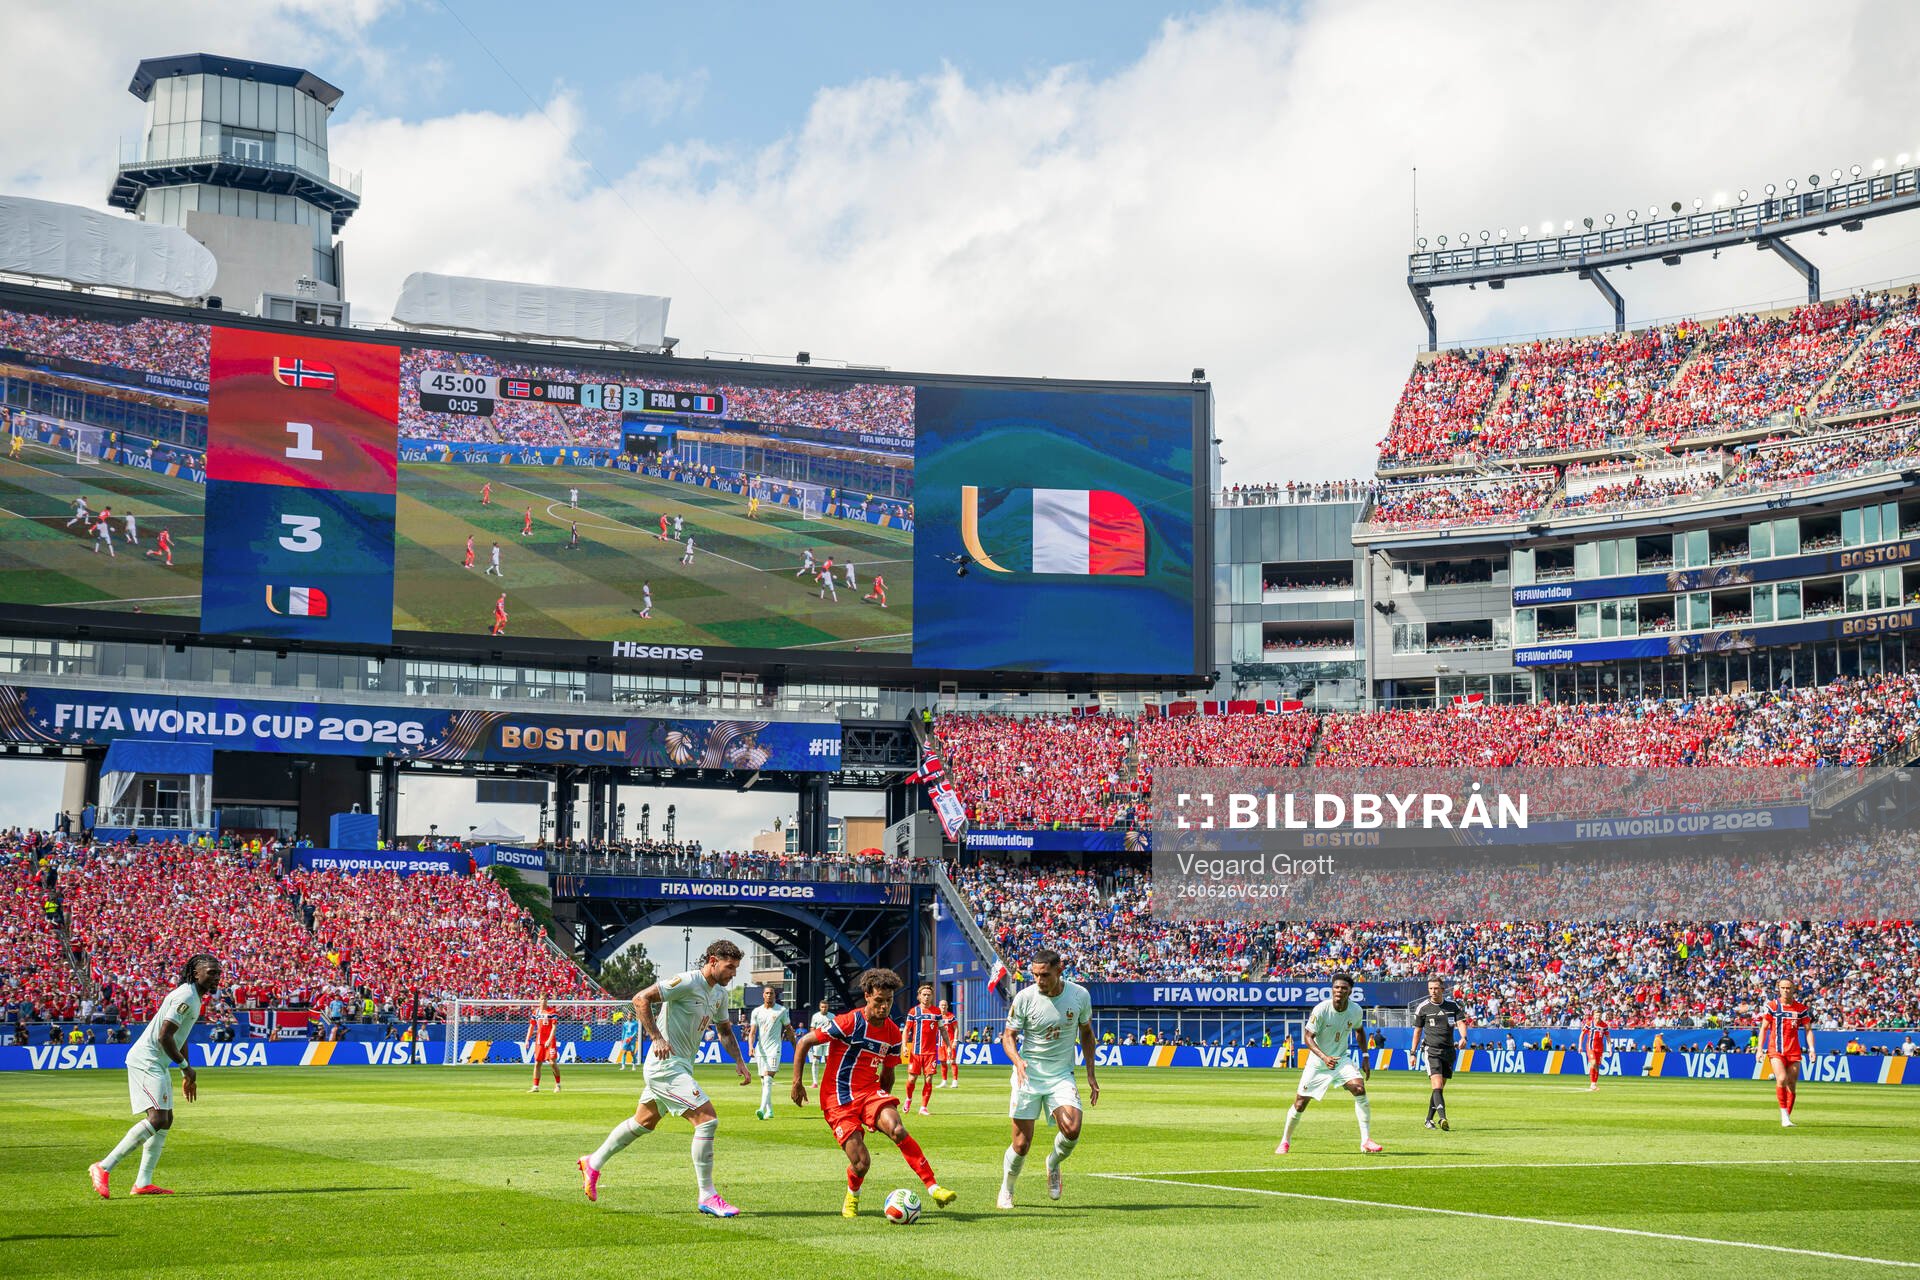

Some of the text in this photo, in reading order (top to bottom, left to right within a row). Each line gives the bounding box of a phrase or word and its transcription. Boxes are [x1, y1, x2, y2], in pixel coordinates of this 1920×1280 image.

[146, 374, 163, 384] FIFA
[163, 376, 193, 390] WORLD
[431, 374, 487, 394] 45:00
[547, 384, 595, 403] NOR 1
[628, 391, 676, 408] 3 FRA
[448, 398, 478, 413] 0:05
[18, 426, 39, 440] VISA
[285, 421, 323, 461] 1
[859, 434, 874, 444] FIFA
[874, 436, 901, 447] WORLD
[69, 437, 92, 455] VSA
[127, 452, 152, 470] VISA
[401, 450, 428, 462] VISA
[464, 453, 489, 464] VISA
[521, 455, 543, 465] VISA
[573, 457, 593, 466] VISA
[618, 460, 631, 472] VISA
[648, 466, 662, 478] VISA
[682, 474, 697, 485] VISA
[716, 479, 732, 493] VISA
[754, 488, 771, 501] VISA
[796, 496, 816, 511] VSA
[845, 506, 868, 522] VISA
[279, 513, 322, 552] 3
[1840, 543, 1911, 567] BOSTON
[1842, 612, 1913, 635] BOSTON
[612, 640, 704, 660] Hisense
[55, 703, 427, 746] FIFA WORLD CUP 2026
[501, 725, 627, 752] BOSTON
[1576, 811, 1773, 838] FIFA WORLD CUP 2026
[967, 834, 1034, 848] #FIFAWorldCup
[1303, 831, 1380, 848] BOSTON
[312, 858, 450, 872] FIFA WORLD CUP 2026
[496, 850, 543, 866] BOSTON
[660, 883, 815, 898] FIFA WORLD CUP 2026
[1153, 987, 1365, 1002] FIFA WORLD CUP 206
[23, 1045, 98, 1070] VISA
[196, 1042, 268, 1066] VISA
[360, 1041, 427, 1065] VISA
[955, 1043, 993, 1065] ISA
[1074, 1045, 1123, 1066] VSA
[1194, 1046, 1249, 1068] VISA
[1487, 1050, 1526, 1073] VISA
[1580, 1051, 1622, 1076] VSA
[1681, 1052, 1730, 1079] VISA
[1801, 1055, 1852, 1082] VISA
